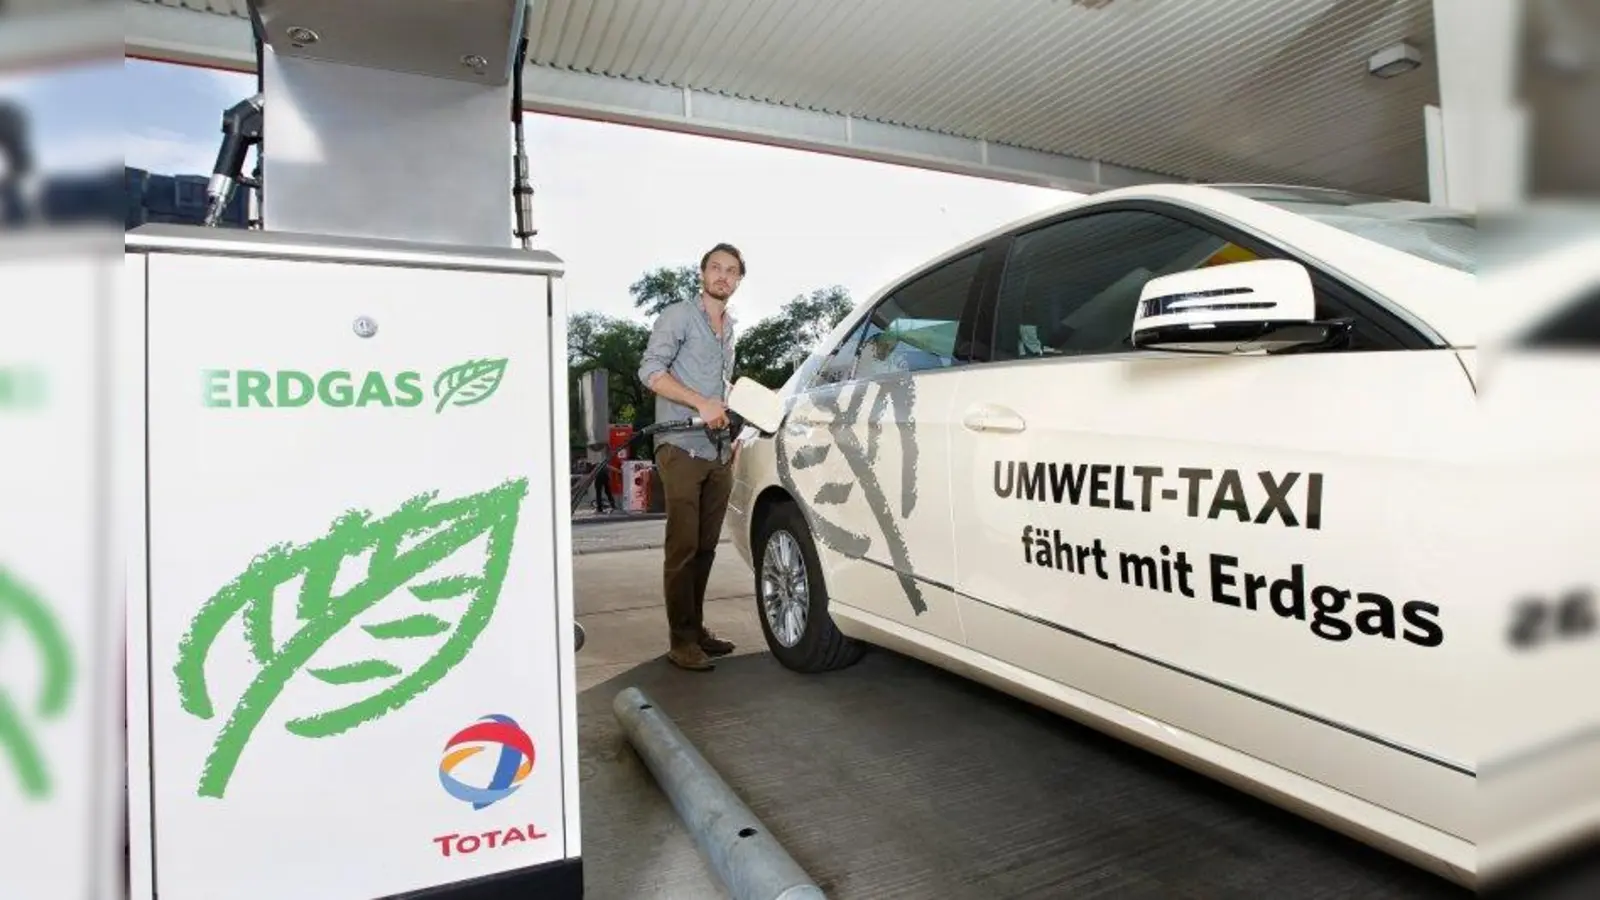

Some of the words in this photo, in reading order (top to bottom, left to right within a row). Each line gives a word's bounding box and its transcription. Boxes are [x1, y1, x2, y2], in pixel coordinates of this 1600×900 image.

[202, 369, 424, 408] ERDGAS
[993, 460, 1324, 530] UMWELT-TAXI
[1021, 525, 1109, 580] fährt
[1119, 545, 1196, 598] mit
[1209, 553, 1444, 648] Erdgas
[433, 824, 547, 857] TOTAL
